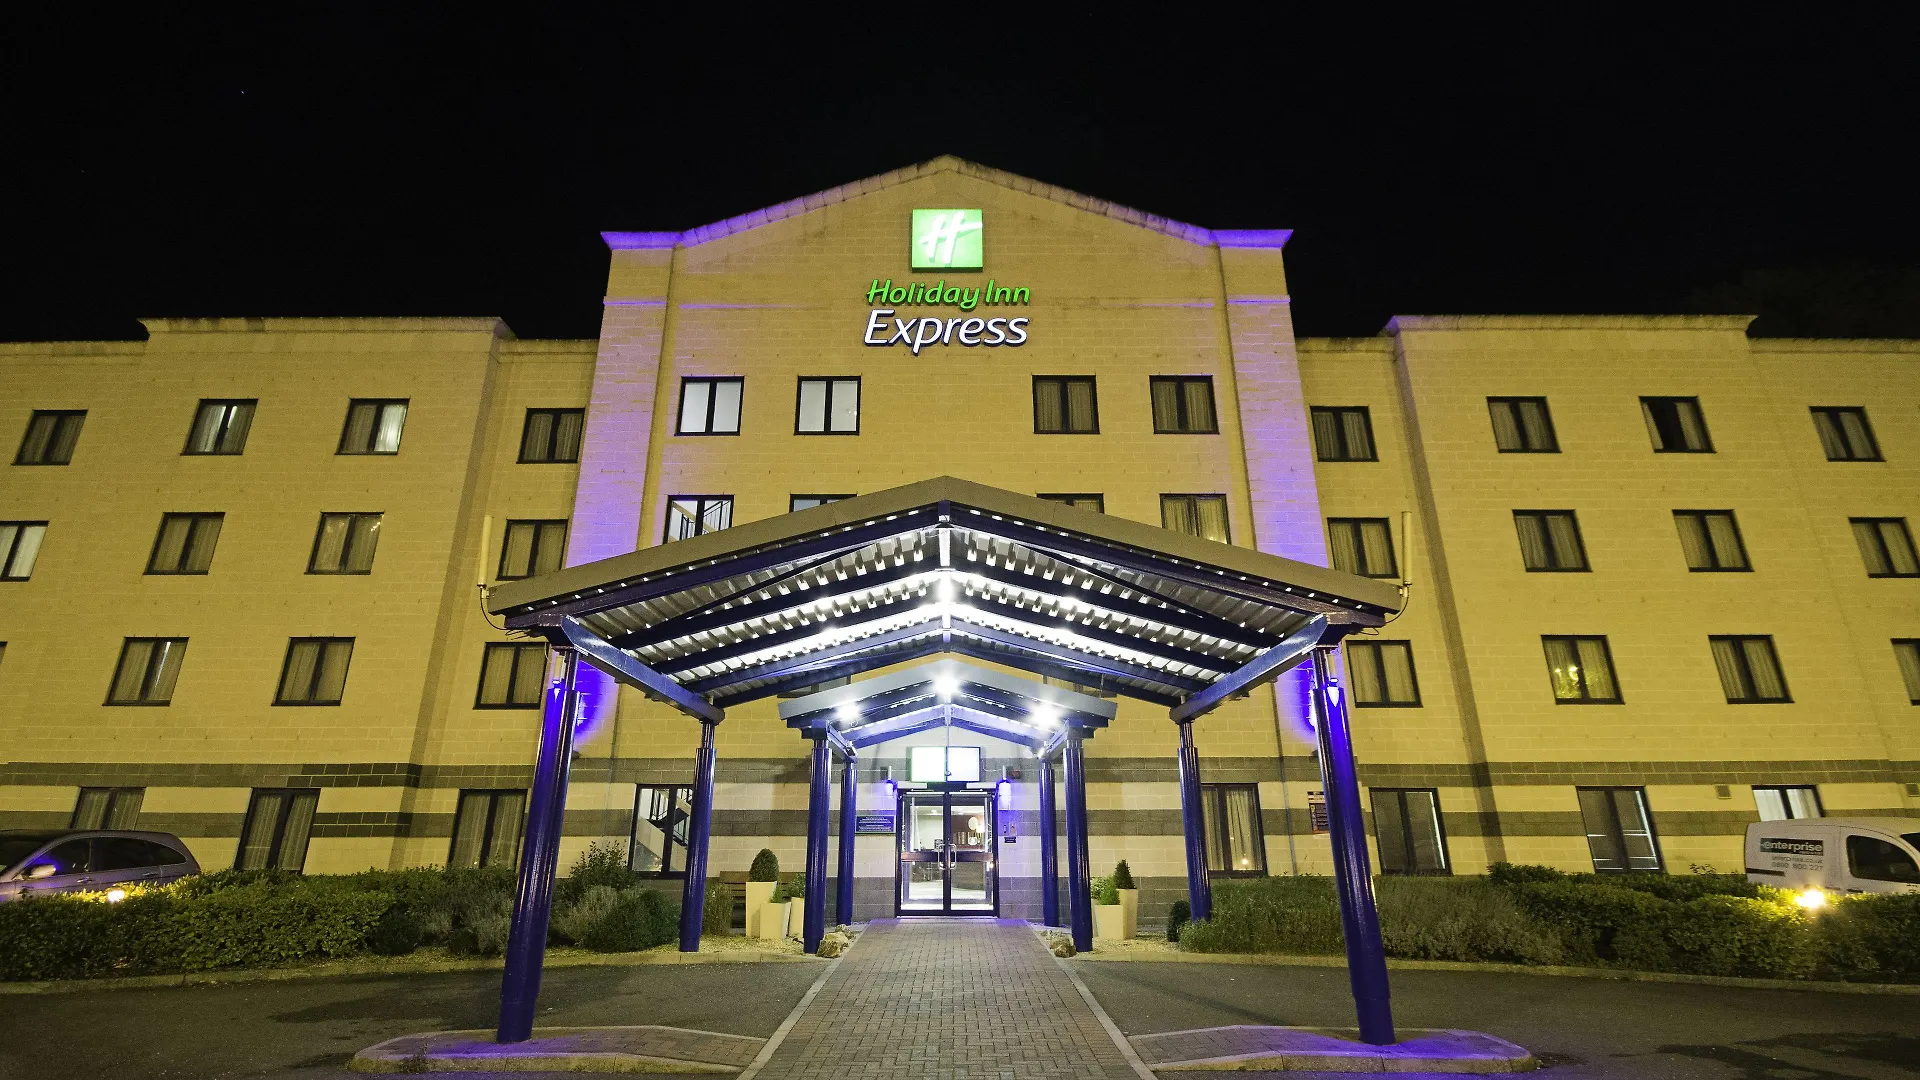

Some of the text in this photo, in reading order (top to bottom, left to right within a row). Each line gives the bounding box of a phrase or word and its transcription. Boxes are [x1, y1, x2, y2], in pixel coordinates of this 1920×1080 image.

[866, 279, 1032, 312] Holiday Inn
[863, 309, 1030, 356] Express
[1761, 841, 1823, 852] enterprise
